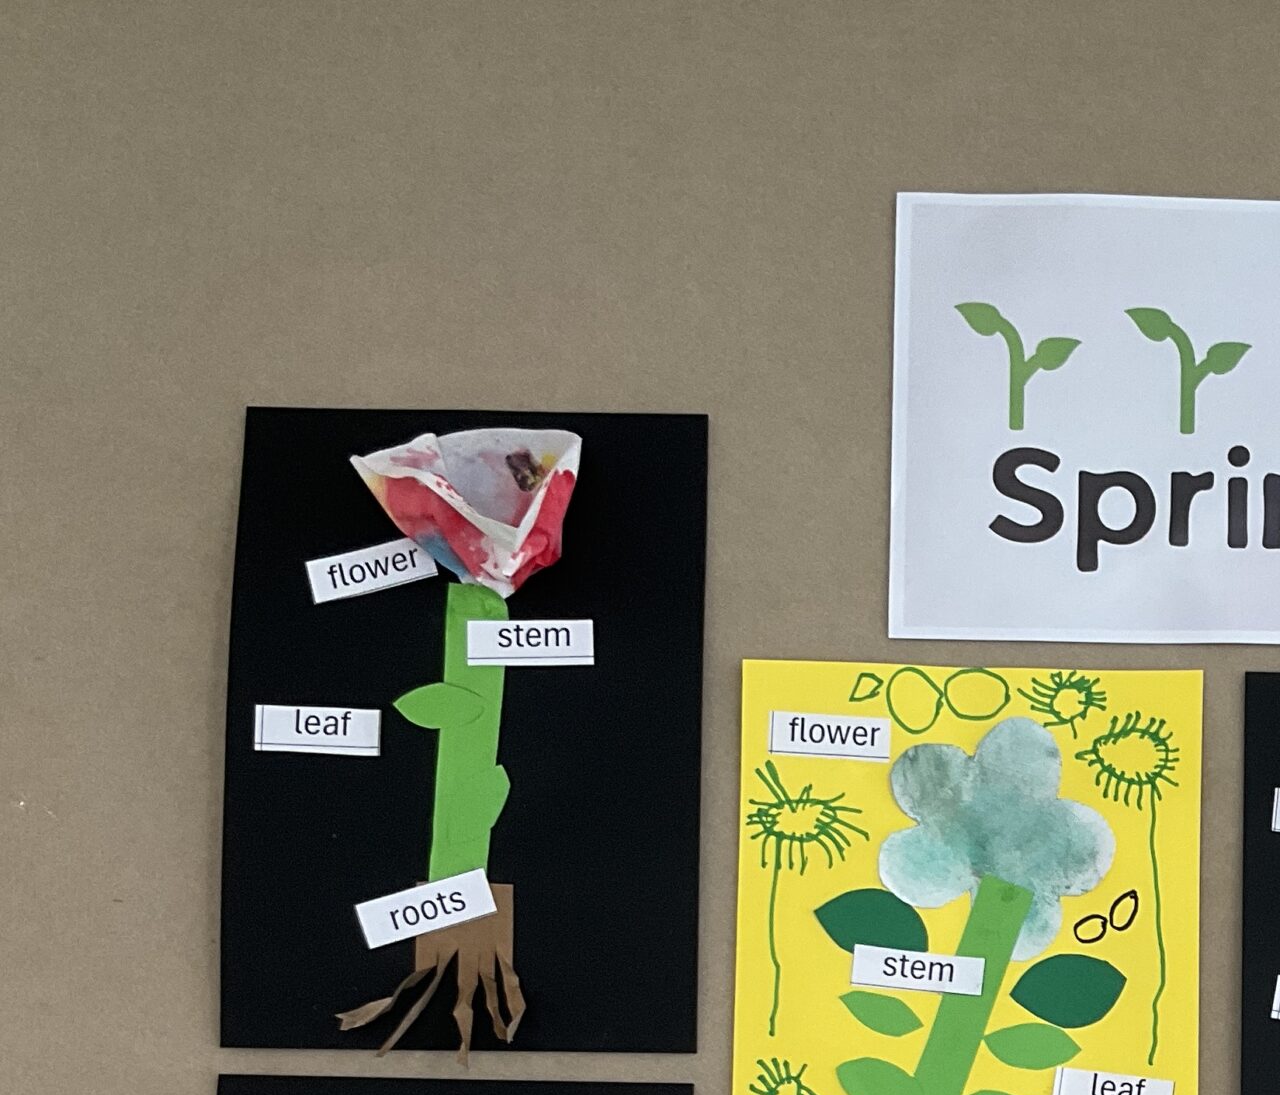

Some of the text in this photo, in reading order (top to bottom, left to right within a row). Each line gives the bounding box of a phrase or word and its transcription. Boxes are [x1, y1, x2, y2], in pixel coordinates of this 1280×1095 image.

[328, 549, 418, 588] flower
[498, 624, 571, 647] stem
[295, 710, 352, 735] leaf
[789, 718, 880, 746] flower
[390, 888, 466, 929] roots
[883, 955, 954, 981] stem
